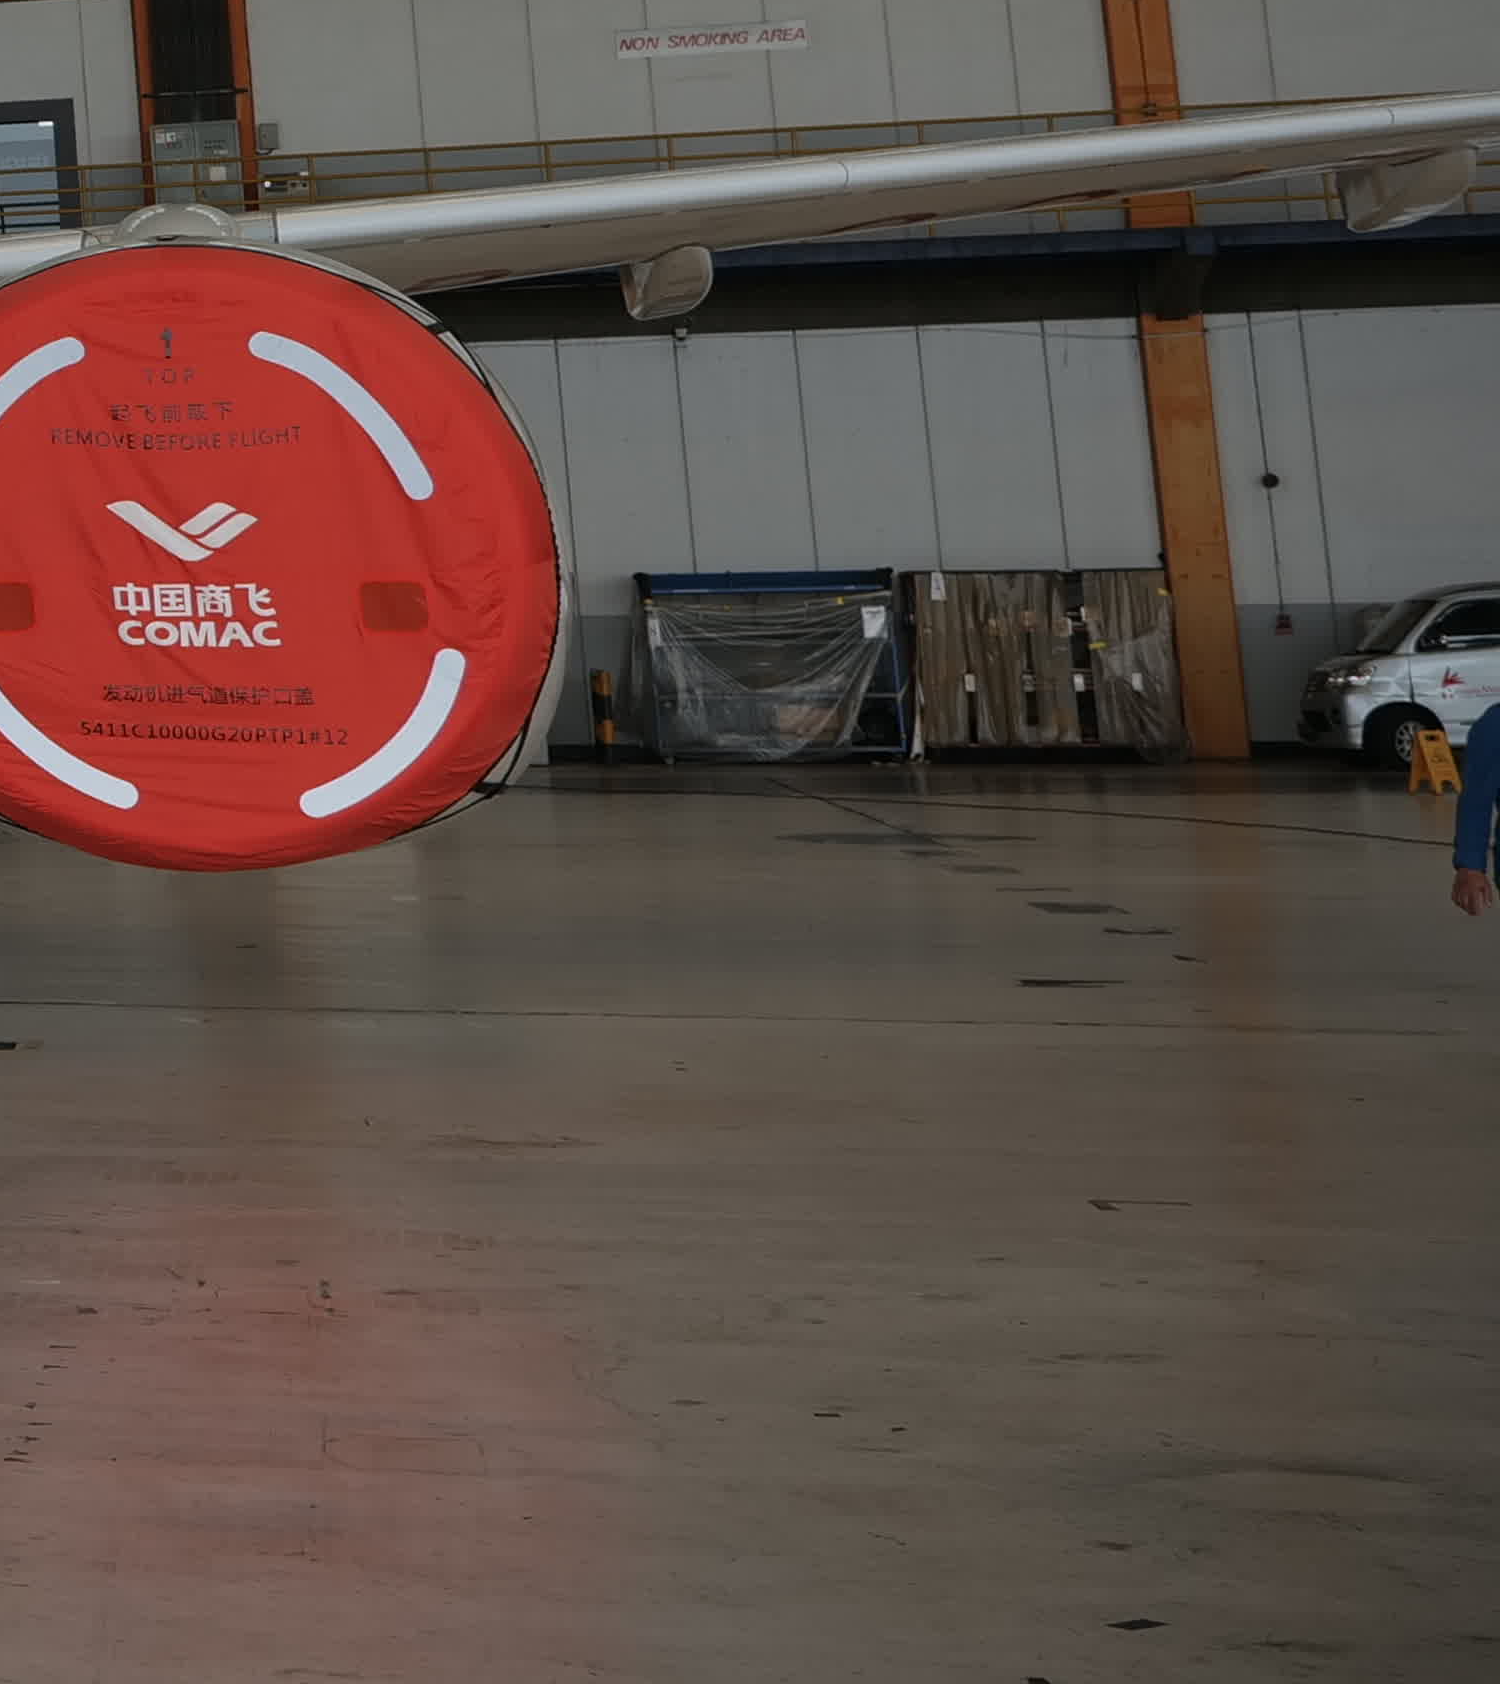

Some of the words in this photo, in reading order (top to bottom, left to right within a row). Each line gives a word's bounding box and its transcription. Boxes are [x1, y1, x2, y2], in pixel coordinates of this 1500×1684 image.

[620, 36, 660, 51] NON
[668, 31, 748, 49] SMOKING
[756, 28, 805, 43] AREA
[143, 368, 196, 385] TOP
[51, 428, 139, 451] REMOVE
[143, 432, 221, 451] BEFORE
[230, 426, 301, 448] FLIGHT
[112, 582, 277, 618] 中国商飞
[118, 619, 282, 648] COMAC
